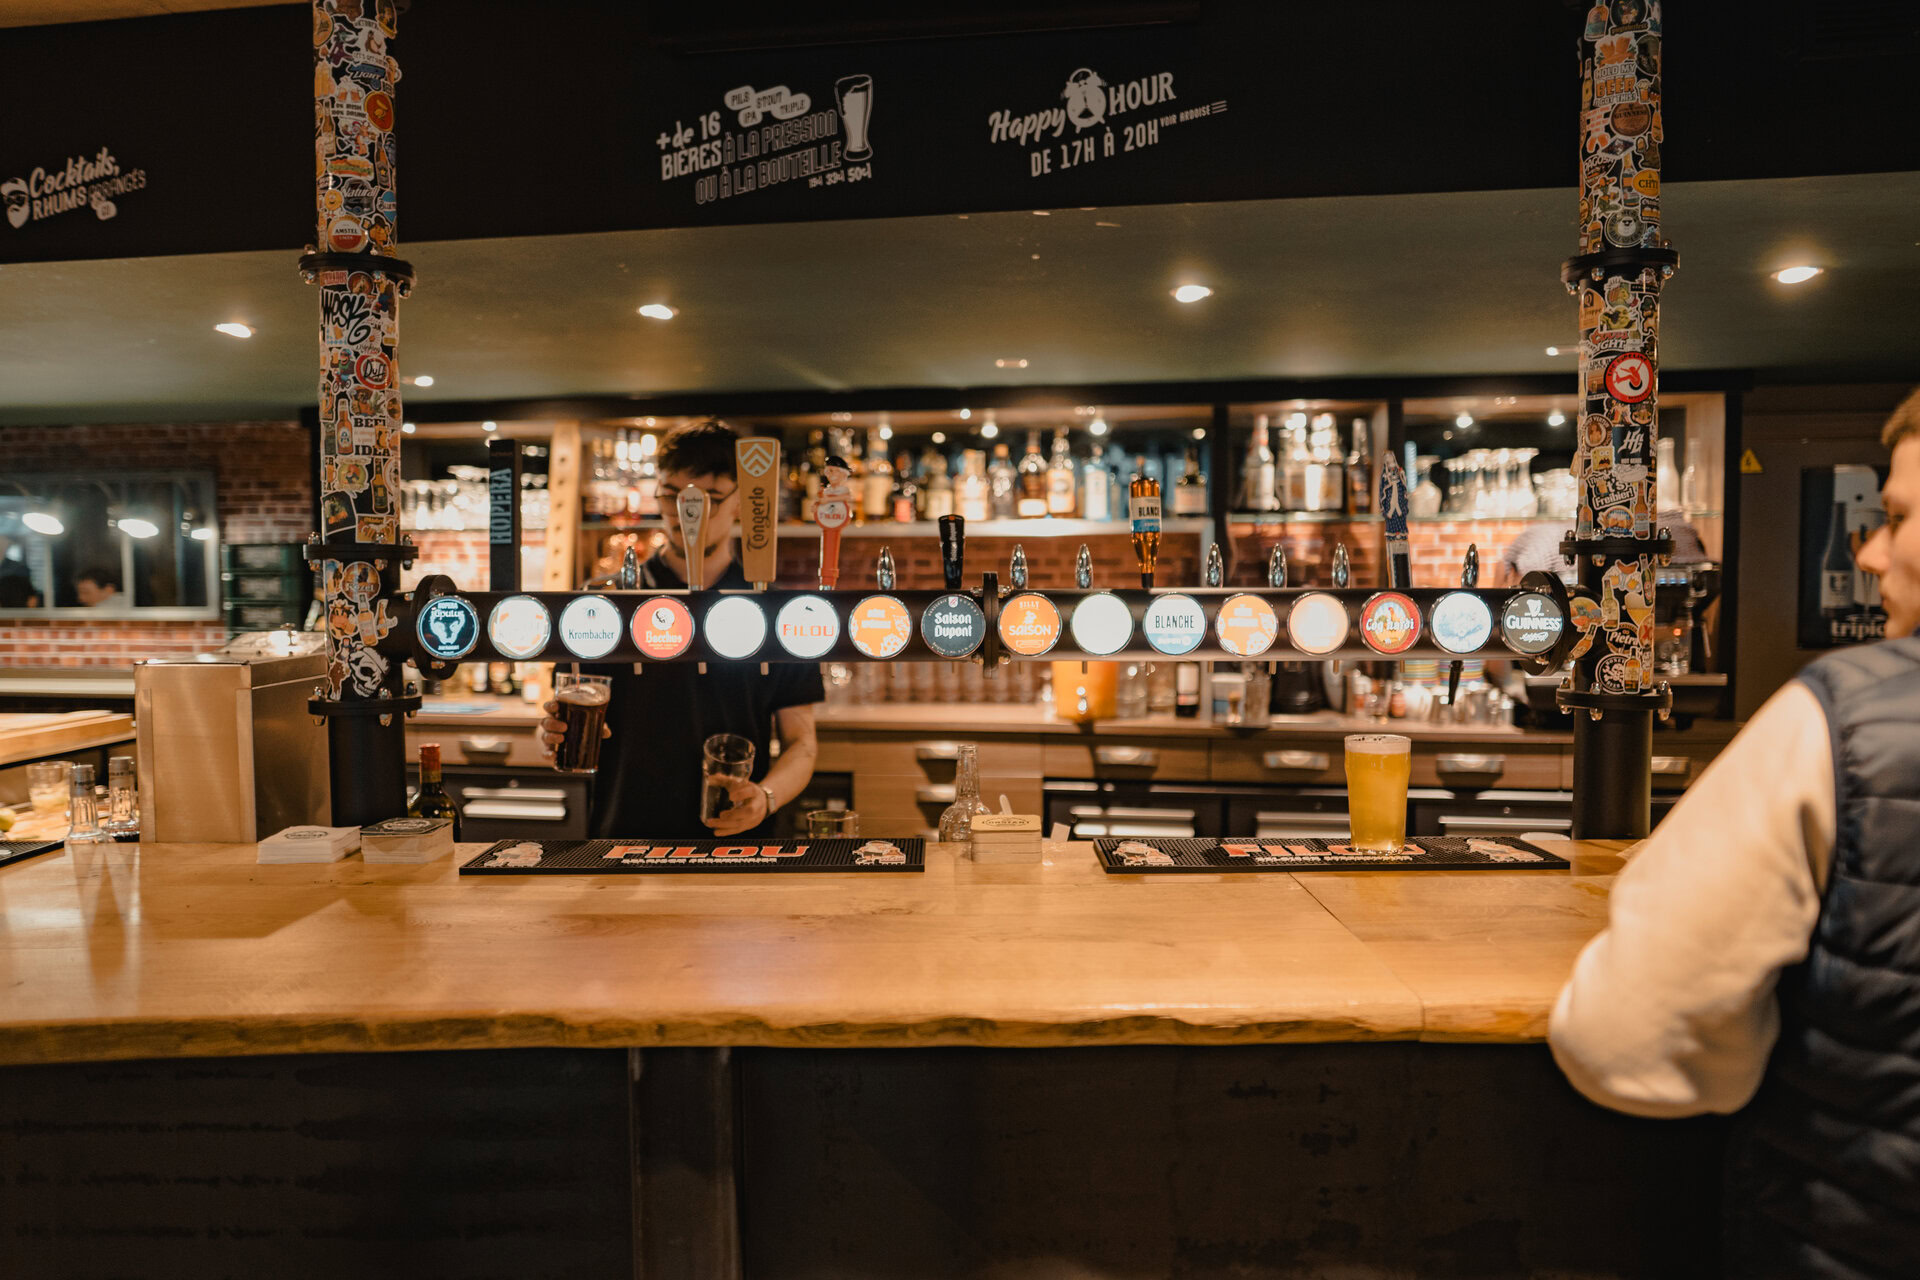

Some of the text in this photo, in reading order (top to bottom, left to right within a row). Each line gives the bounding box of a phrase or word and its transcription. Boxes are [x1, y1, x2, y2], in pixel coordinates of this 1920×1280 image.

[353, 70, 382, 80] LIGHT
[1595, 63, 1636, 78] HOLD MY
[1596, 77, 1636, 98] BEER
[731, 91, 750, 104] PILS
[756, 92, 783, 108] STOUT
[780, 100, 806, 115] TRIPLE
[988, 72, 1177, 146] Happy HOUR
[699, 111, 721, 140] 16
[743, 112, 757, 124] IPA
[662, 109, 838, 180] BIÈRES À LA PRESSION
[1030, 119, 1159, 178] DE 17H À 20H
[696, 141, 840, 205] OU À LA BOUTEILLE
[33, 186, 88, 220] RHUMS
[364, 359, 387, 379] Duff
[1595, 488, 1634, 507] Freibier!
[490, 468, 513, 545] HOPERA
[746, 487, 770, 552] Tongerlo
[1019, 601, 1040, 609] SILLY
[934, 611, 972, 626] Saison
[1155, 614, 1195, 629] BLANCHE
[1365, 616, 1384, 634] Coq
[1505, 614, 1563, 632] GUINNESS
[568, 628, 615, 641] Krombacher
[645, 629, 683, 644] Bacchus
[783, 623, 835, 637] FILOU
[934, 624, 973, 641] Dupont
[1009, 624, 1052, 636] SAISON
[1609, 631, 1639, 648] Pietra
[602, 844, 811, 860] FILOU
